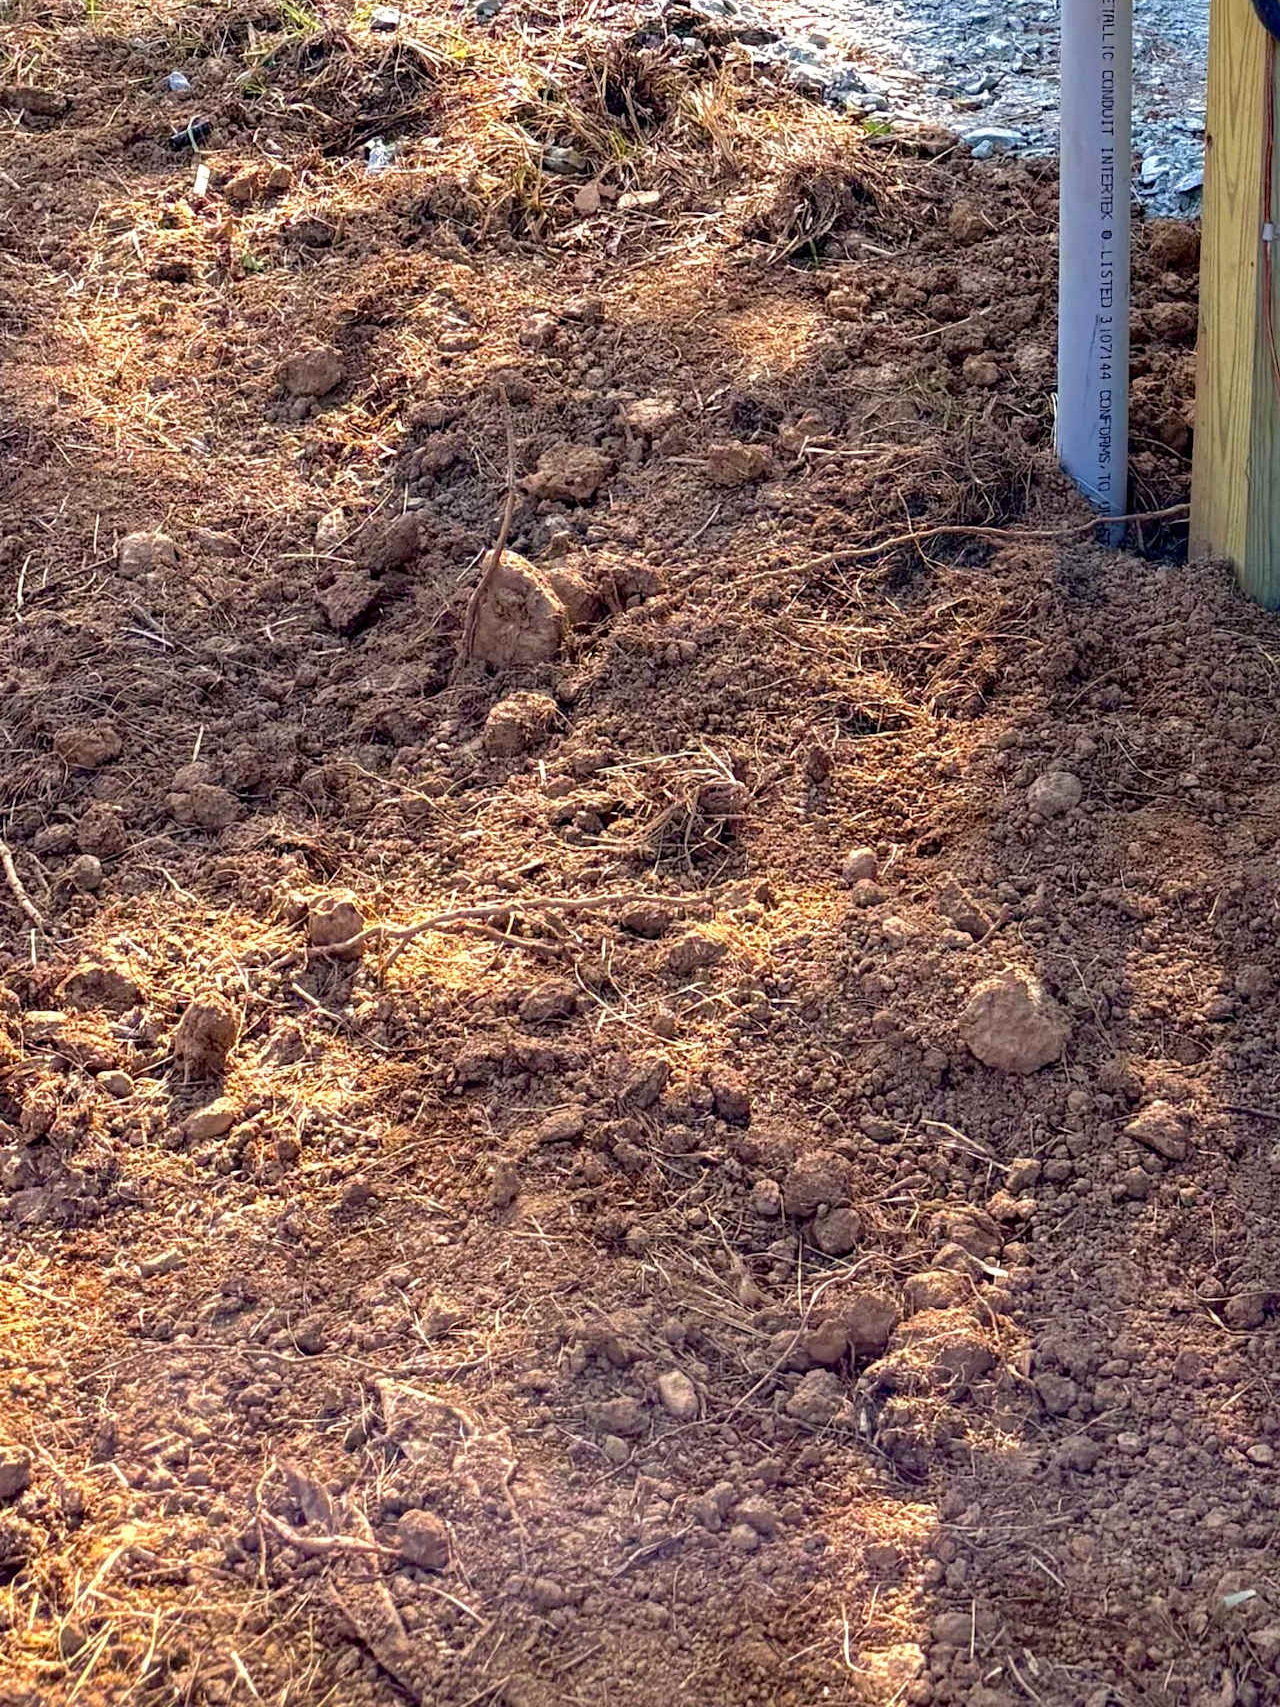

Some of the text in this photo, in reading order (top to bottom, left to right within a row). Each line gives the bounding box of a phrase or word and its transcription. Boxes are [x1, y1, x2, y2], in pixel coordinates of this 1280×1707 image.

[1101, 70, 1115, 137] CONDUIT
[1100, 147, 1114, 220] INTERTEK
[1099, 251, 1113, 308] LISTED
[1099, 316, 1113, 380] 3107144
[1098, 475, 1111, 492] TO
